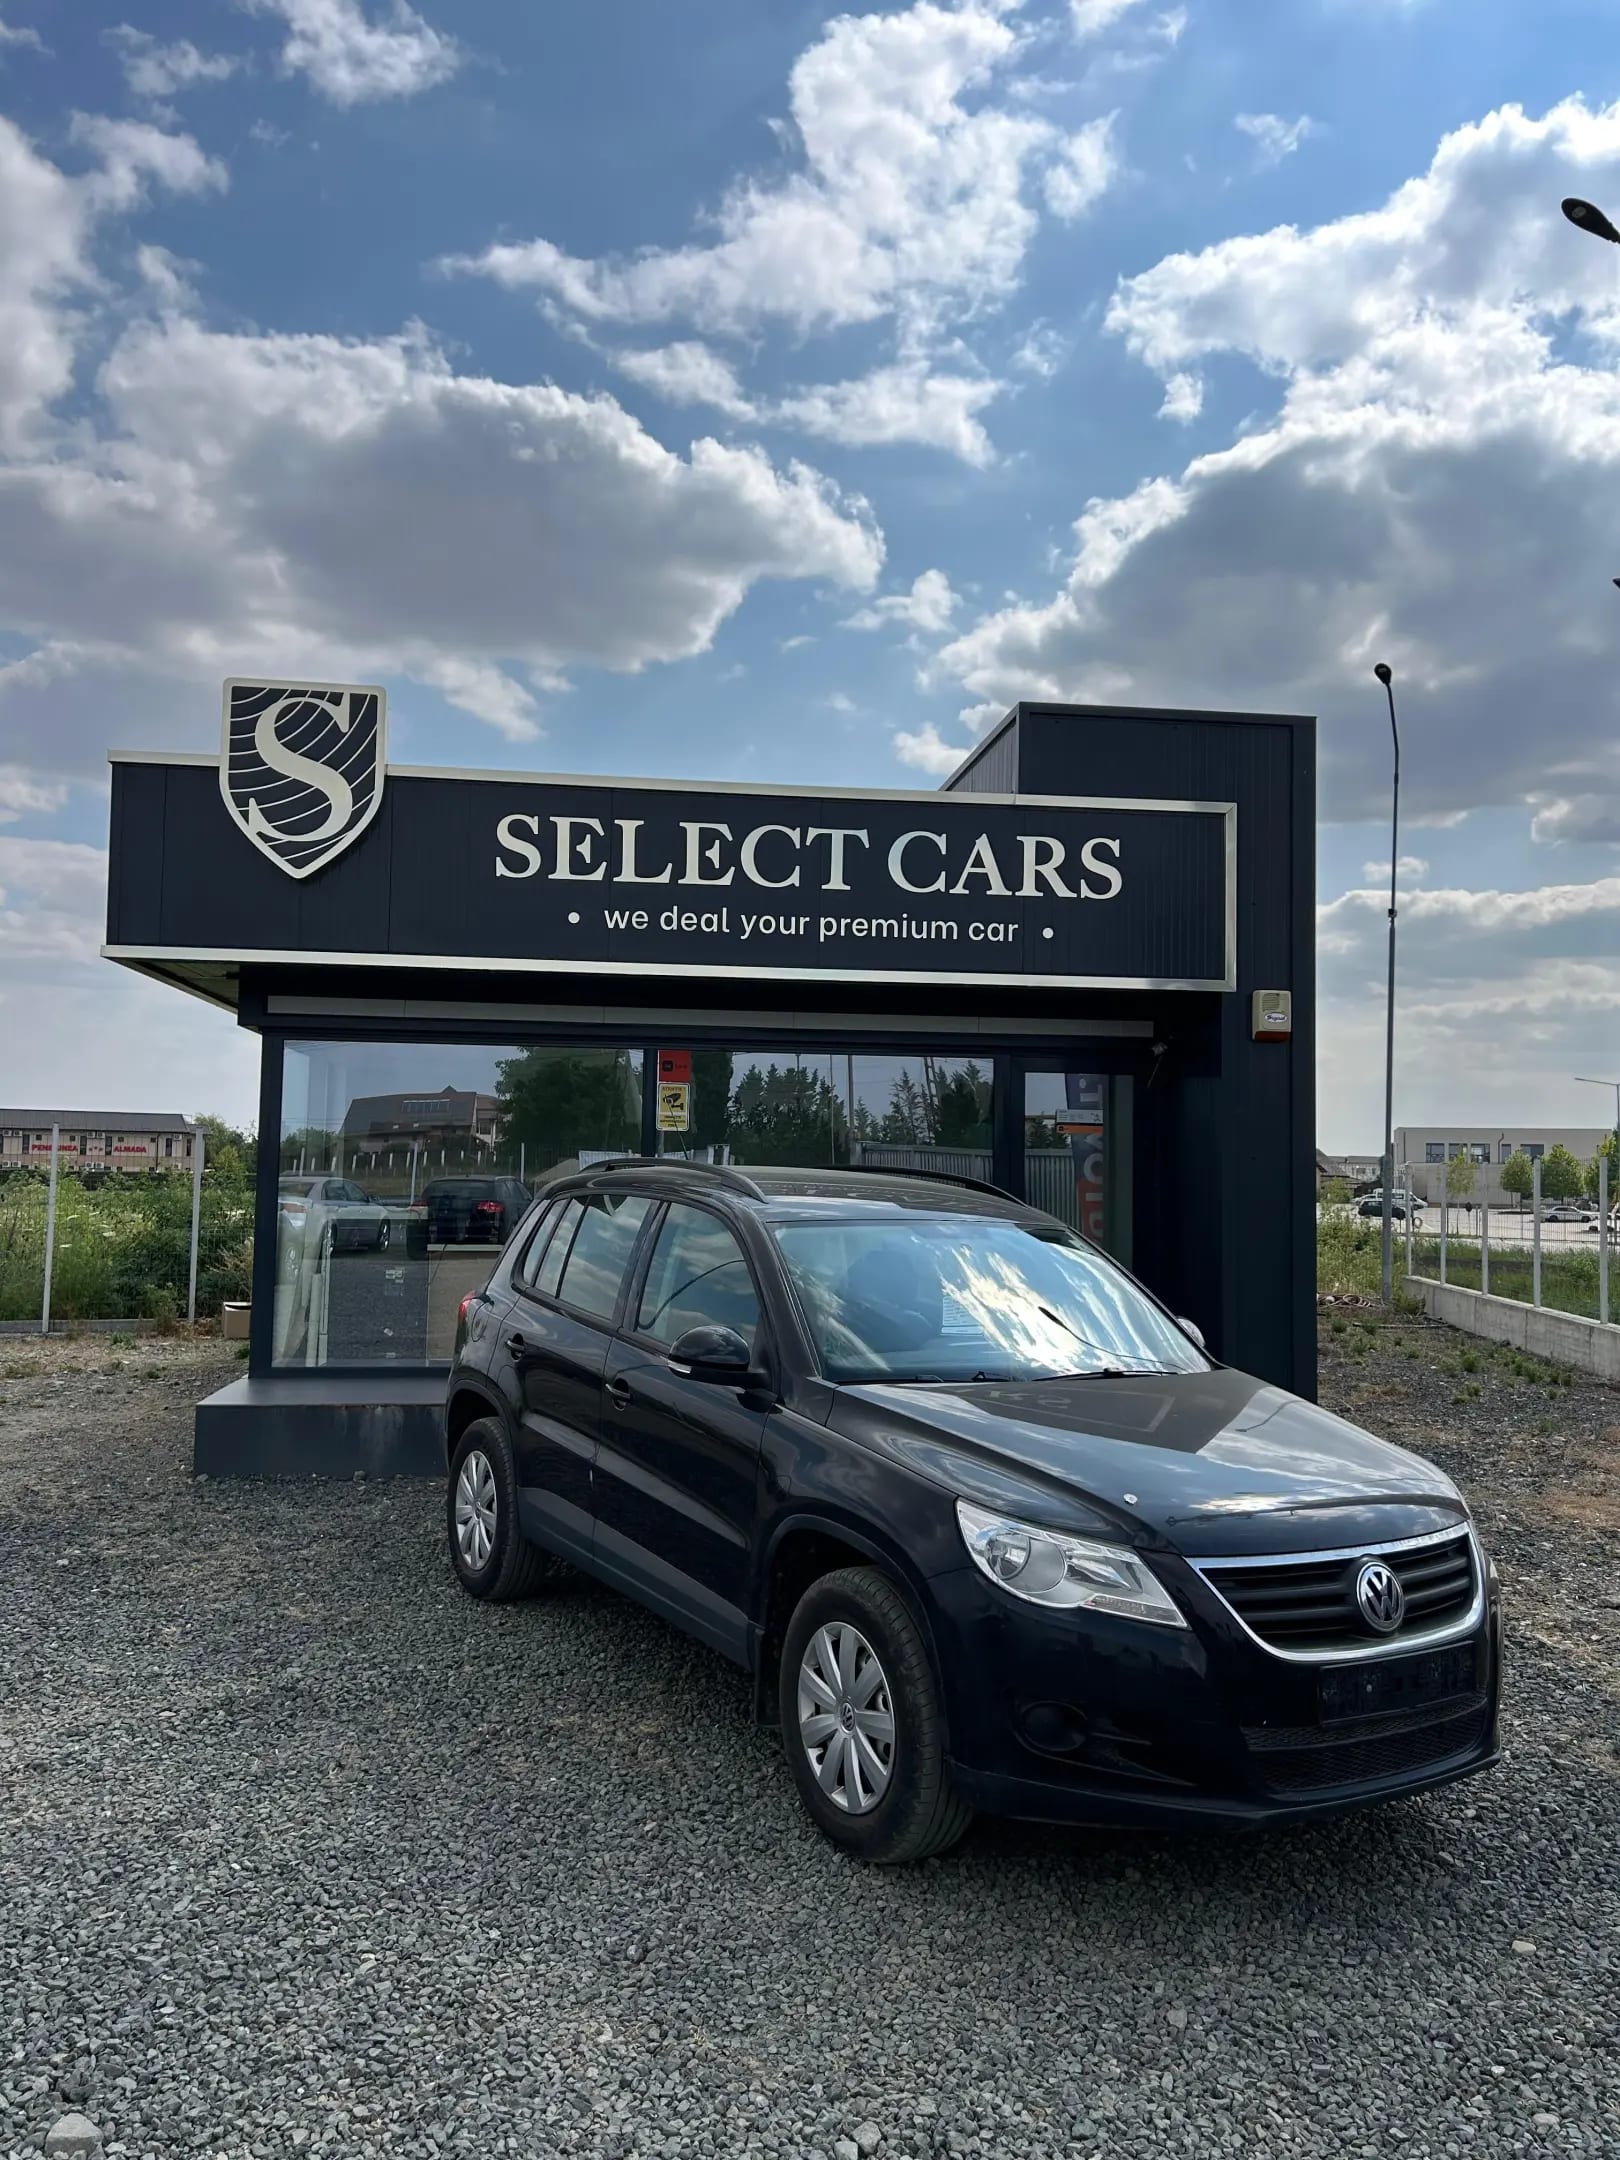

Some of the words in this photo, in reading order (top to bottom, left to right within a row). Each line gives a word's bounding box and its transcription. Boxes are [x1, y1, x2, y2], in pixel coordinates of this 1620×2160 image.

[495, 814, 870, 891] SELECT
[887, 830, 1124, 900] CARS
[603, 910, 649, 930] we
[659, 905, 730, 933] deal
[740, 914, 810, 940] your
[819, 912, 958, 943] premium
[968, 922, 1019, 942] car
[32, 1144, 78, 1152] PENSUNEA
[113, 1145, 147, 1153] ALMADA
